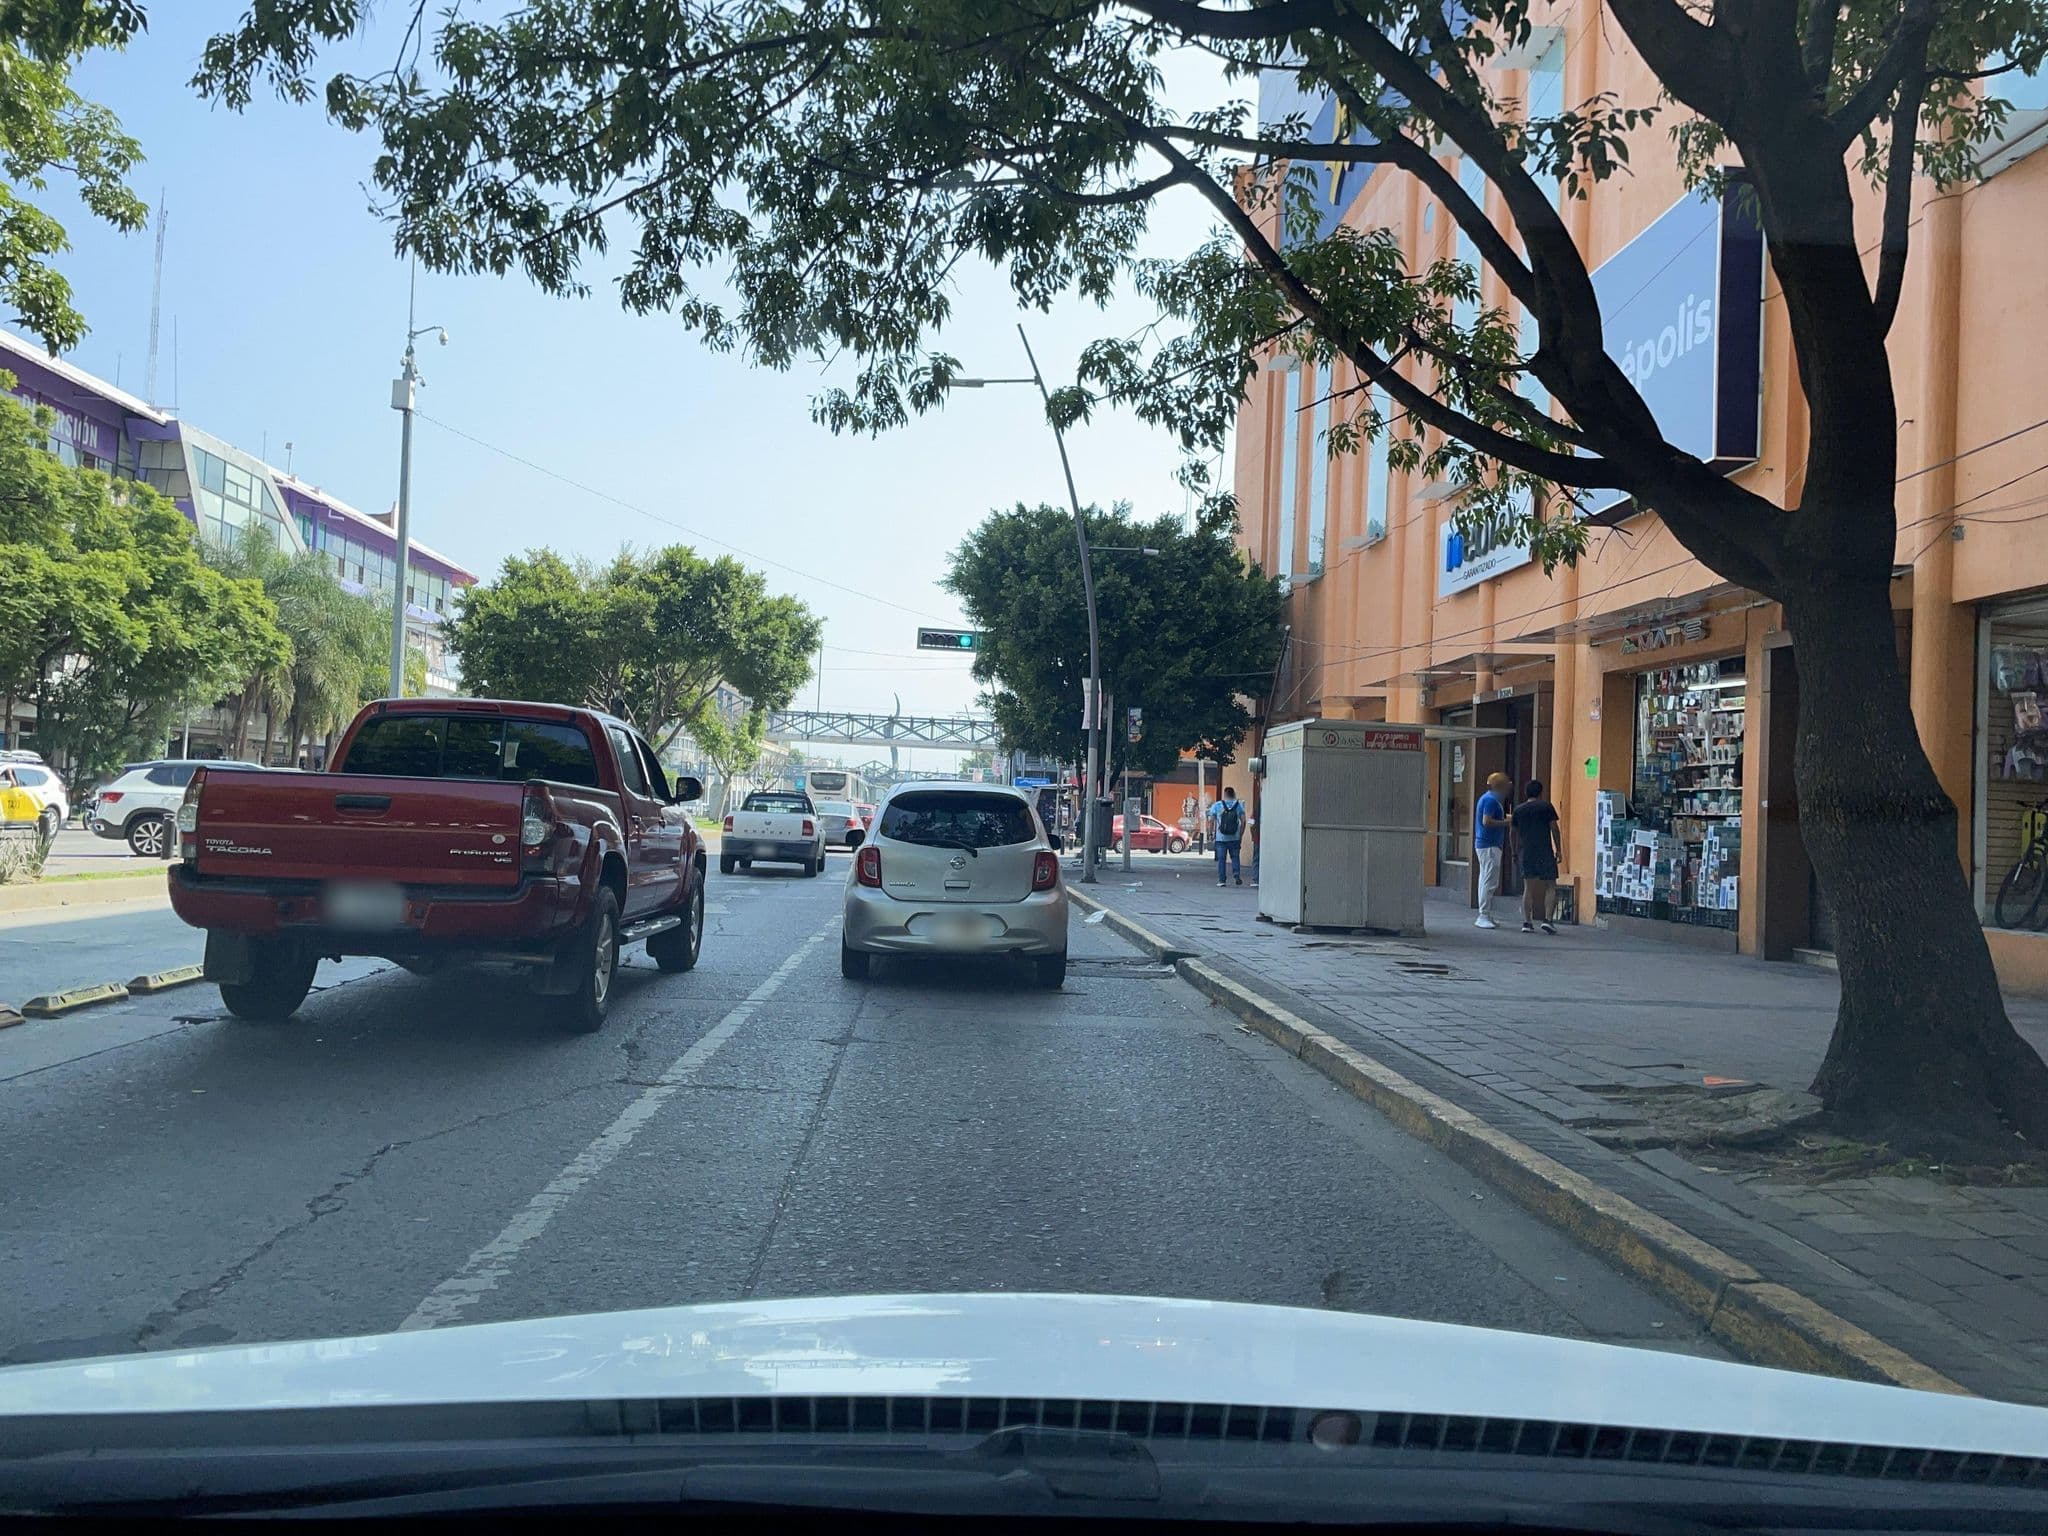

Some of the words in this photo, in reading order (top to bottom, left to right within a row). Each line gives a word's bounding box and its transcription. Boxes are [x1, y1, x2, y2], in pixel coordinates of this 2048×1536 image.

[1463, 558, 1497, 580] GARANTIZADO
[205, 838, 234, 846] TOYOTA
[206, 845, 273, 855] TACOMA
